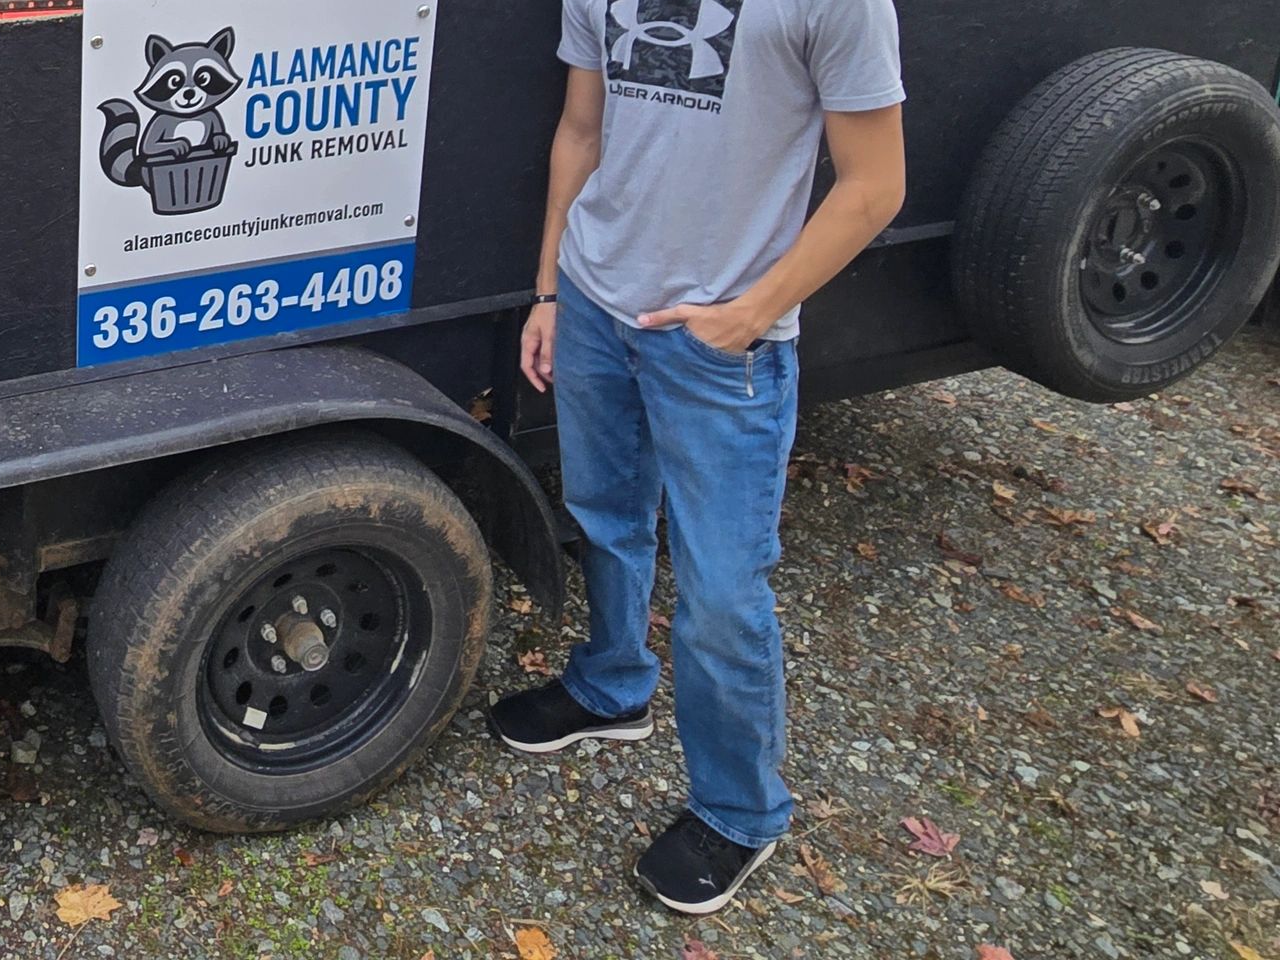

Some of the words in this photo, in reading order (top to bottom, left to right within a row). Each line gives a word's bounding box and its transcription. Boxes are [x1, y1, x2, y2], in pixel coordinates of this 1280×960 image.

[247, 37, 420, 89] ALAMANCE
[245, 77, 417, 139] COUNTY
[244, 142, 303, 168] JUNK
[311, 129, 408, 160] REMOVAL
[123, 202, 383, 252] alamancecountyjunkremoval.com
[92, 259, 403, 348] 336-263-4408
